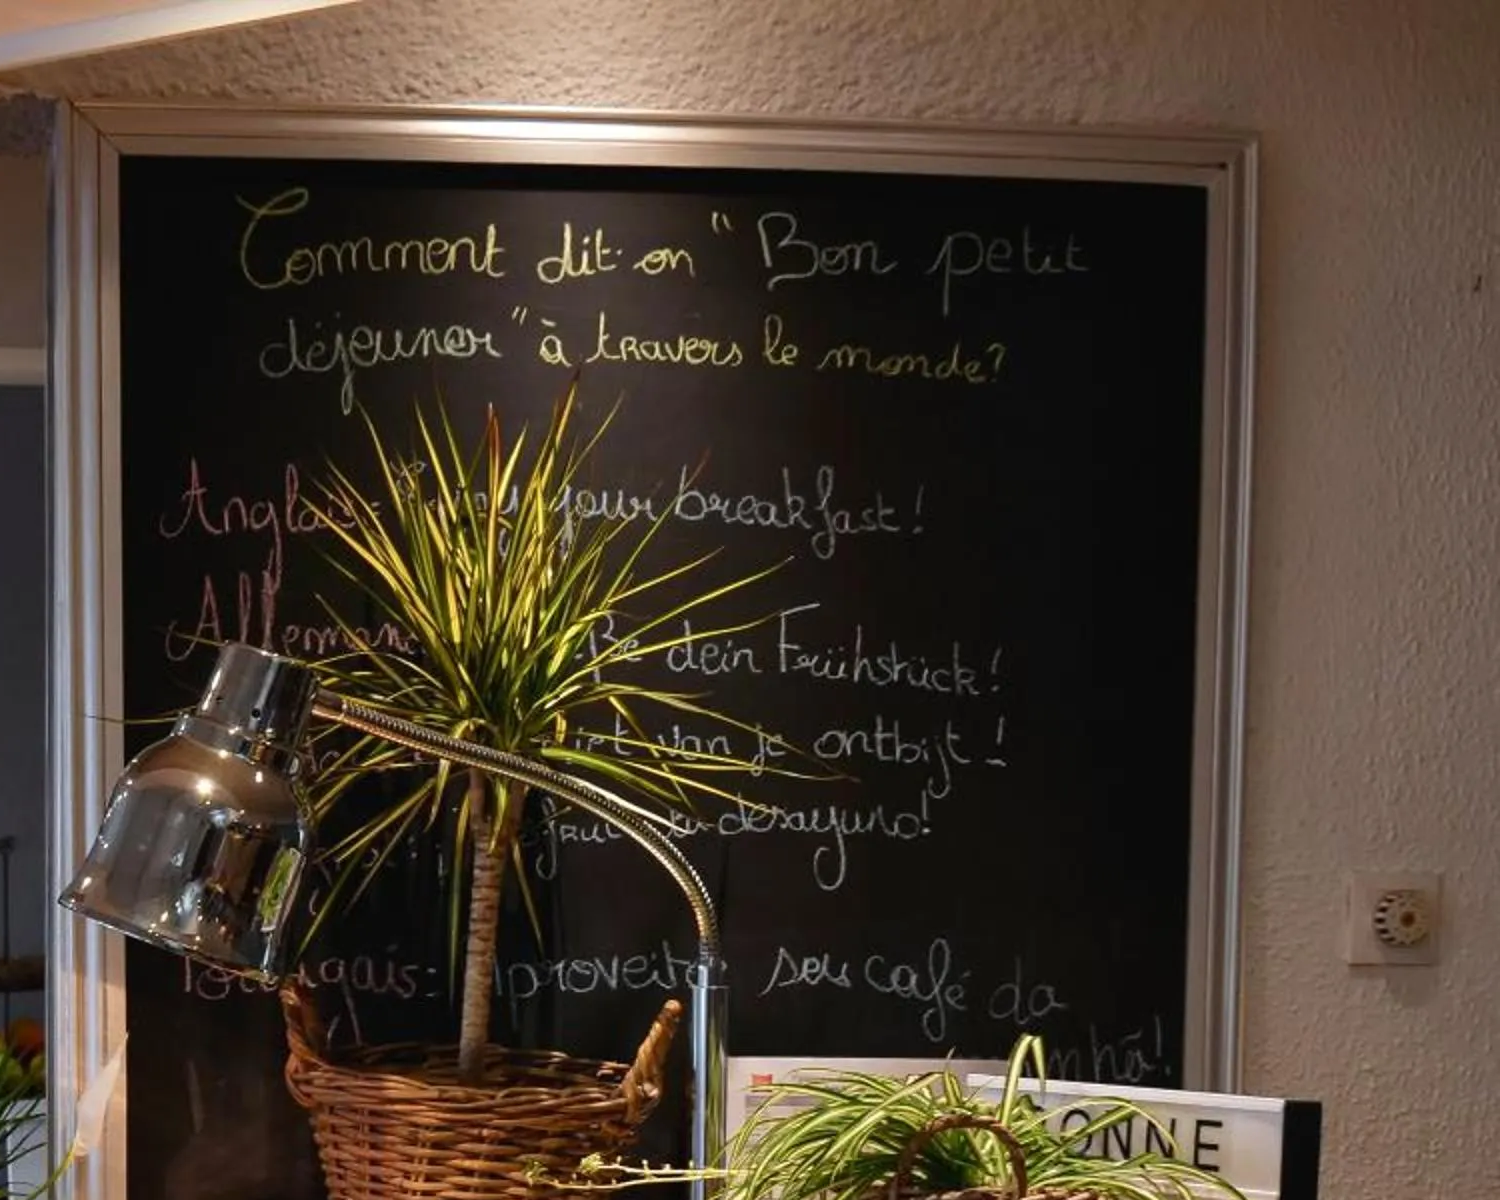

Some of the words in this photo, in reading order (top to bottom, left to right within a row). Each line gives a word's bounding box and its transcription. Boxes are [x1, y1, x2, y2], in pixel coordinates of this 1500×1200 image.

[234, 187, 505, 289] Comment
[926, 226, 1090, 318] petit
[585, 310, 744, 368] travers
[762, 313, 799, 366] le
[816, 342, 1007, 384] monde?
[666, 618, 763, 676] dein
[864, 938, 973, 1042] café
[988, 955, 1068, 1025] da
[1038, 1106, 1224, 1173] ONNE
